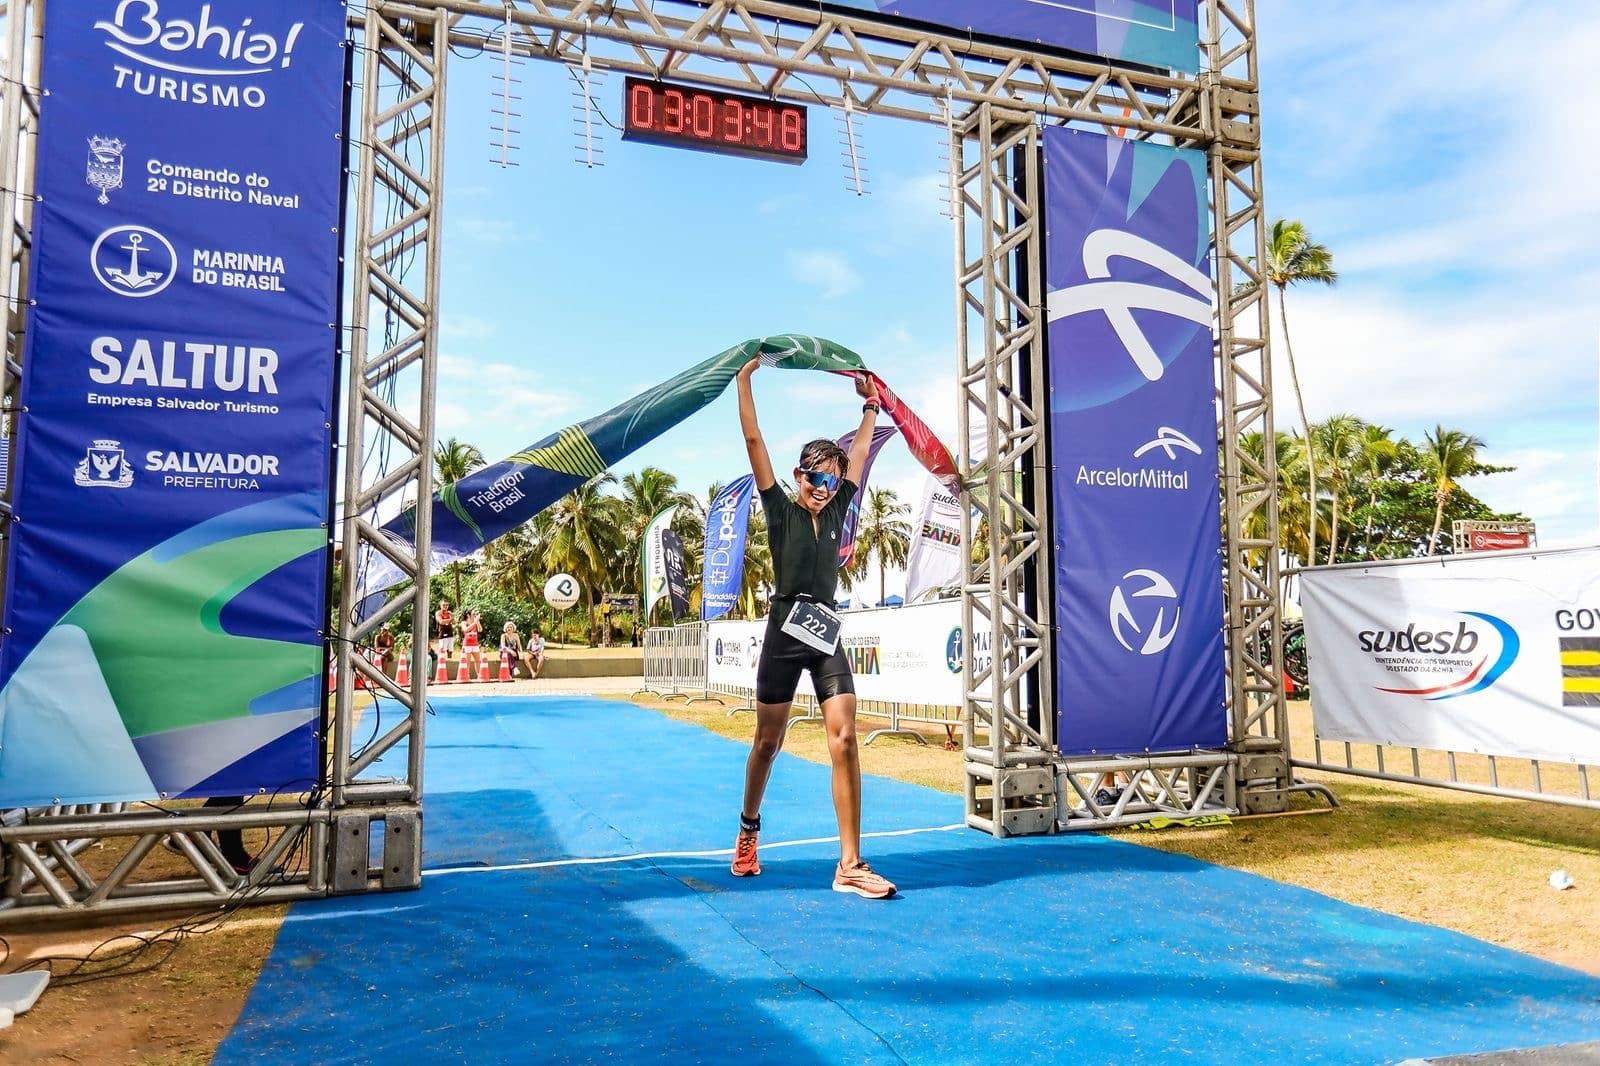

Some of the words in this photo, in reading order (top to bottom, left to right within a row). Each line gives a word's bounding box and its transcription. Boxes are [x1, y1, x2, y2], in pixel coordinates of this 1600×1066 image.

[113, 64, 266, 108] TURISMO
[632, 84, 801, 151] 03:03:48
[147, 159, 241, 185] Comando
[245, 171, 270, 188] do
[173, 180, 243, 203] Distrito
[248, 190, 299, 209] Naval
[193, 249, 286, 274] MARINHA
[192, 268, 218, 285] DO
[222, 270, 286, 292] BRASIL
[88, 336, 279, 394] SALTUR
[87, 393, 153, 410] Empresa
[156, 396, 220, 412] Salvador
[224, 400, 279, 415] Turismo
[145, 450, 279, 476] SALVADOR
[163, 475, 260, 490] PREFEITURA
[467, 471, 525, 508] Triathlon
[1075, 464, 1188, 490] ArcelorMittal
[488, 486, 526, 513] Brasil
[931, 492, 961, 508] sude
[801, 613, 828, 639] 222
[1358, 621, 1479, 655] sudesb
